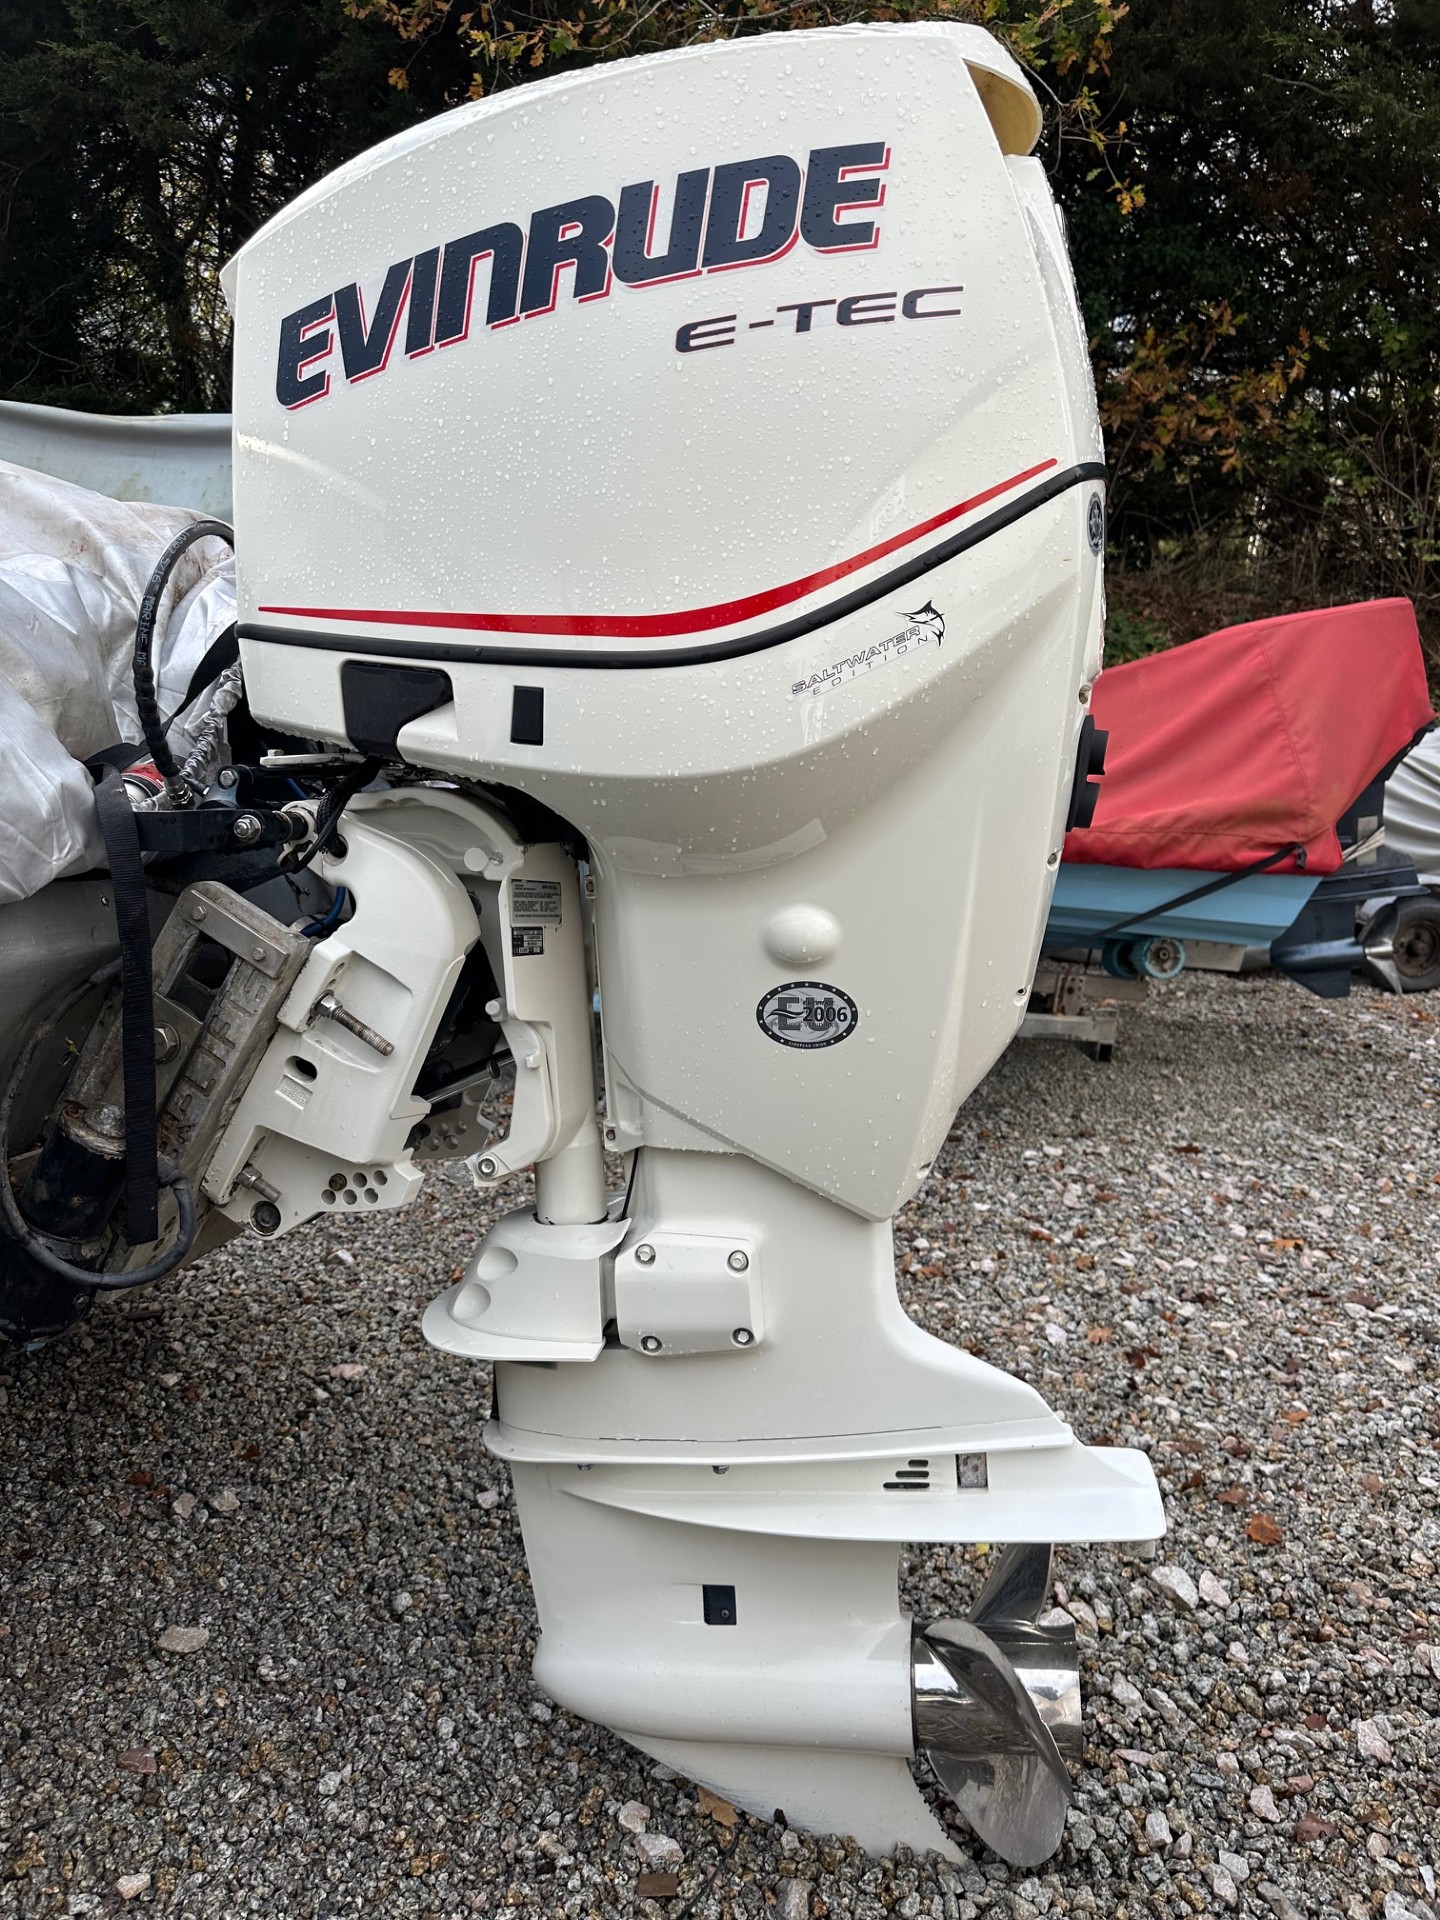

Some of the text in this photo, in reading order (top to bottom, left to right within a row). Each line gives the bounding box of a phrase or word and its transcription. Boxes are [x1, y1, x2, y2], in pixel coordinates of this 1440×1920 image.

[276, 142, 891, 410] EVINRUDE
[675, 285, 964, 352] E-TEC
[152, 557, 171, 583] 5/16
[139, 595, 155, 645] MARINE
[791, 625, 921, 695] SALTWATER
[812, 635, 928, 695] EDITION
[802, 1006, 848, 1022] 2006
